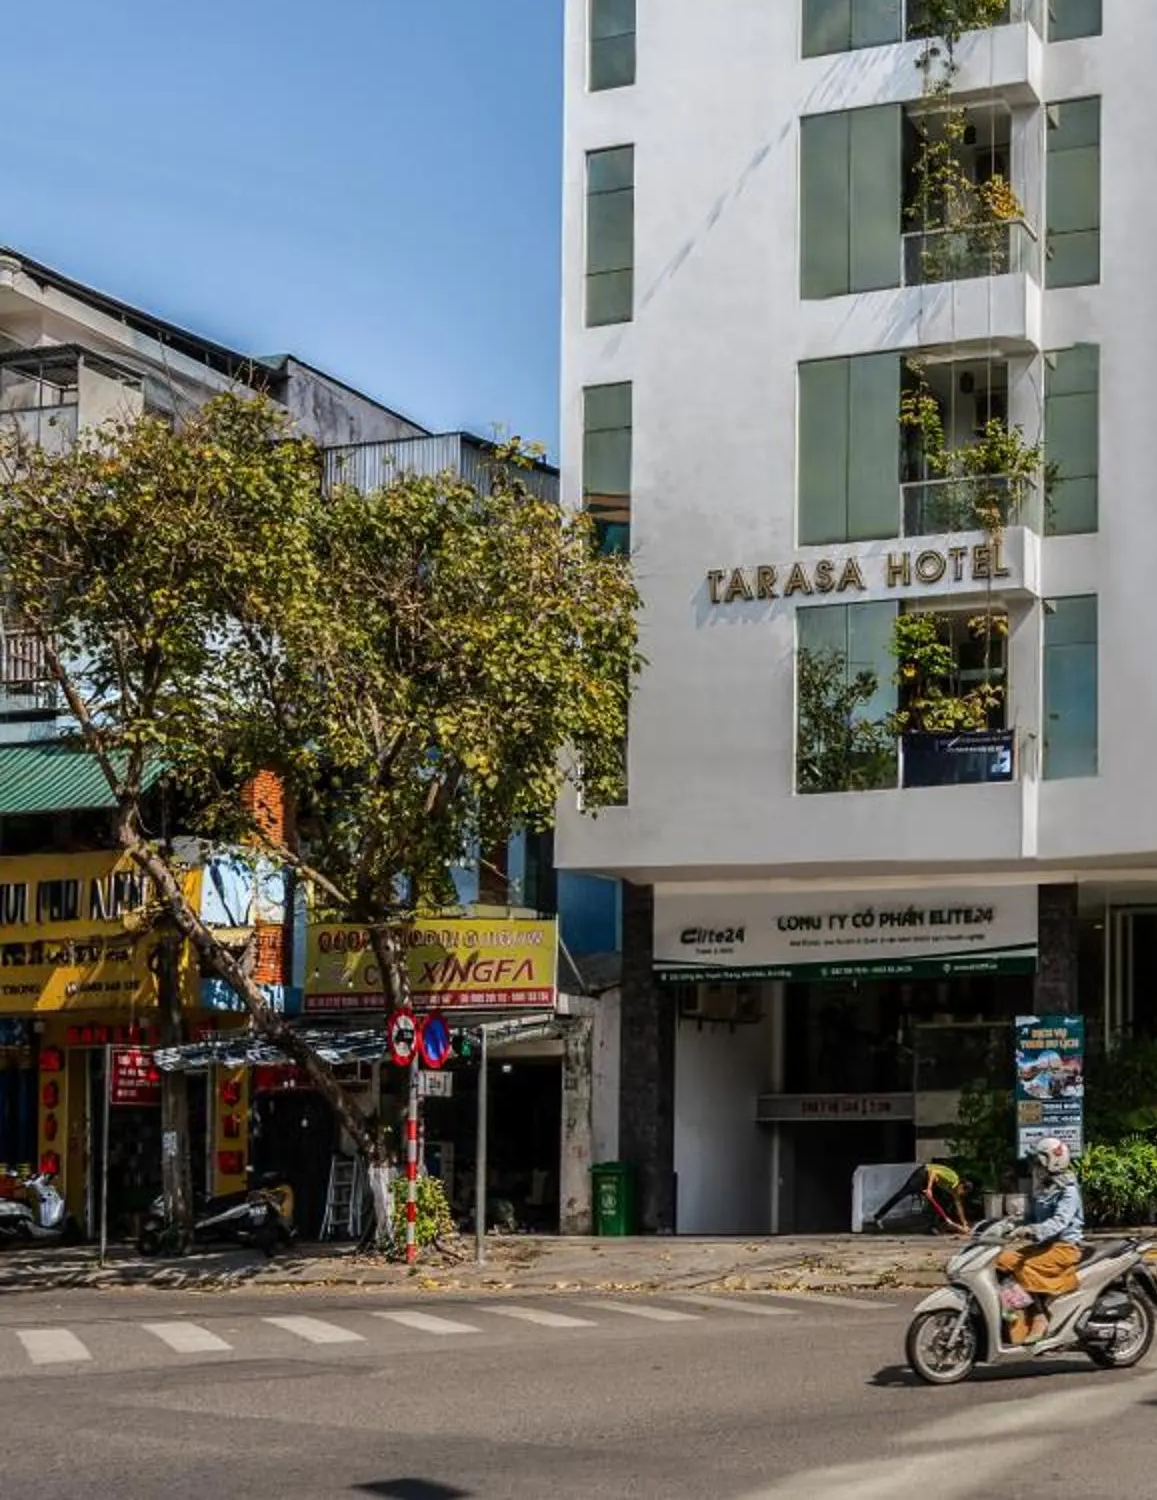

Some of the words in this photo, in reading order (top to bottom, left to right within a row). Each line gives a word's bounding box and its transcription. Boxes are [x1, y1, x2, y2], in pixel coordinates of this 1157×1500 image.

[706, 557, 866, 604] TARASA
[887, 542, 1011, 588] HOTEL
[929, 907, 994, 925] ELITE24
[418, 955, 535, 984] XINGFA
